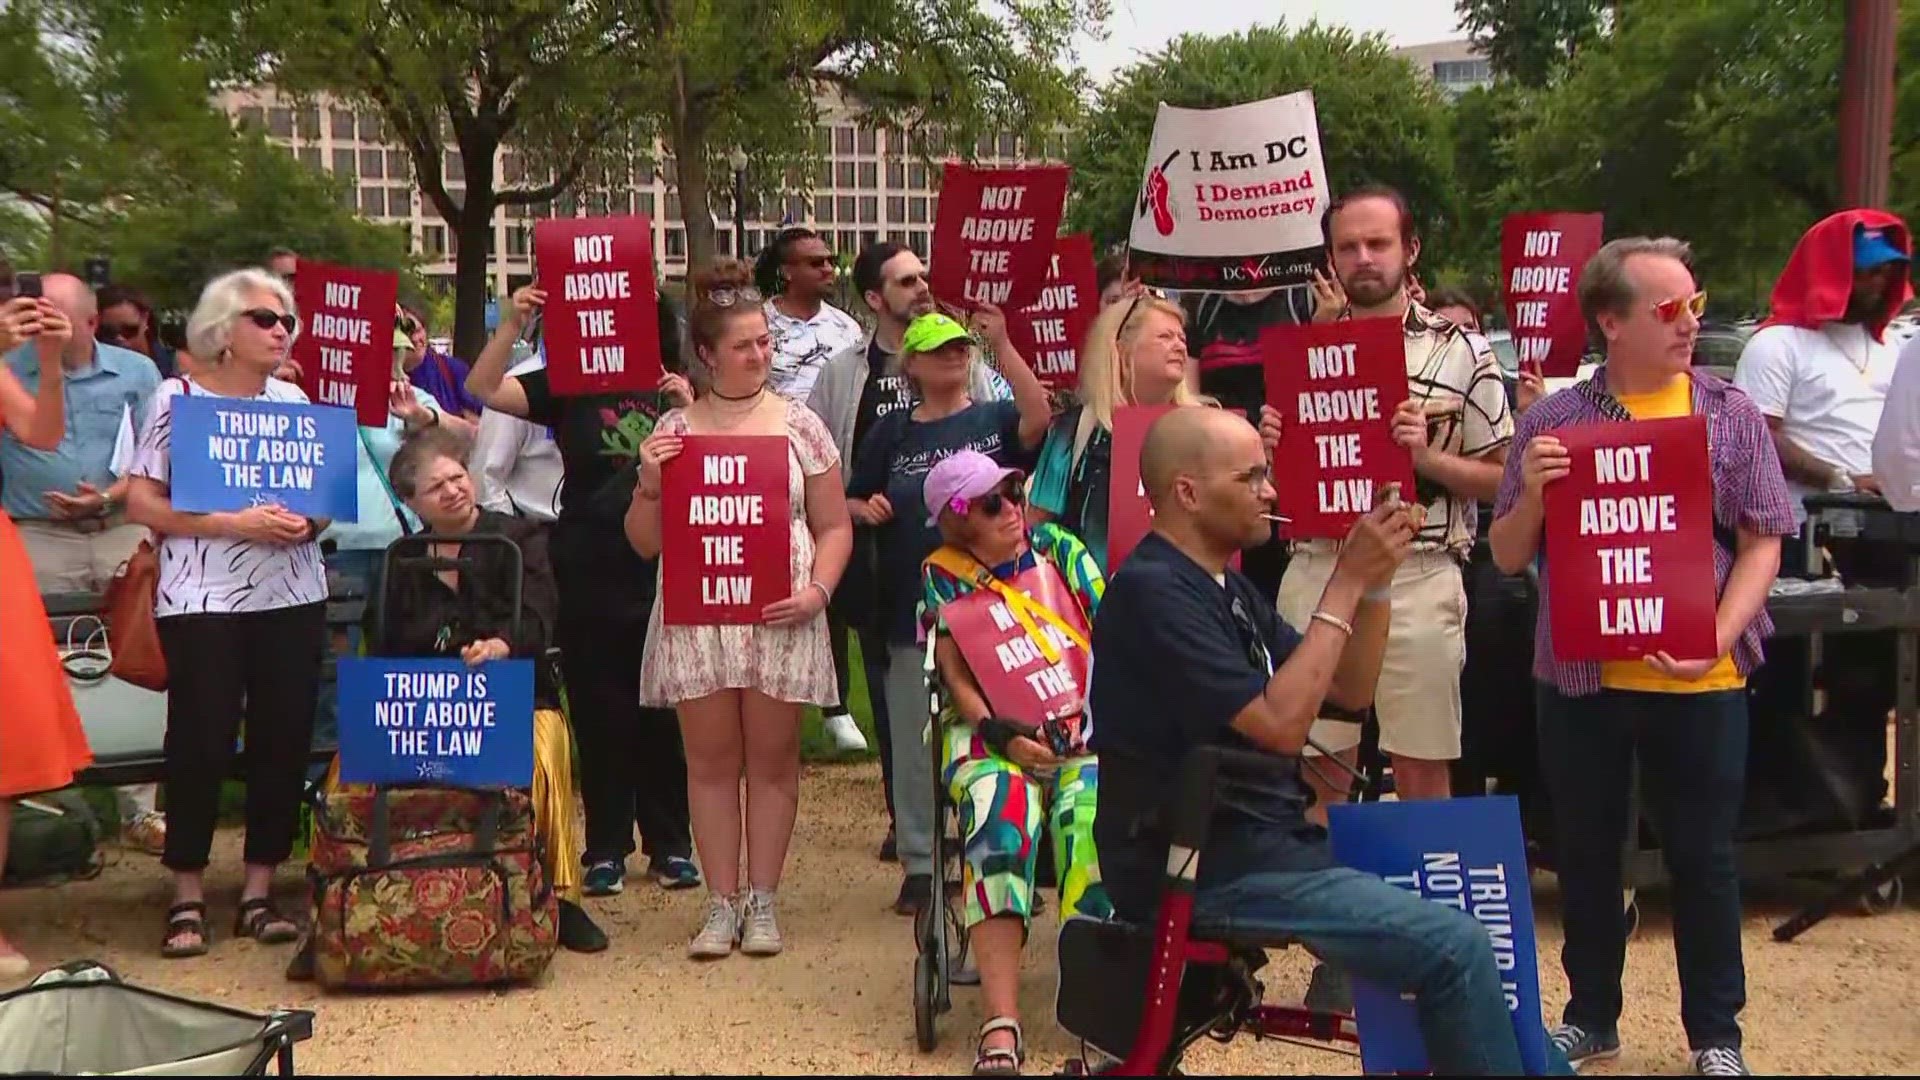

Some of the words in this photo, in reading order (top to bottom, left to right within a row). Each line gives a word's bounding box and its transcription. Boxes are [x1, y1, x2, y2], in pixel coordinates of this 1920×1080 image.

[1190, 151, 1202, 171] I
[1210, 151, 1257, 171] Am
[1264, 136, 1308, 164] DC
[980, 186, 1027, 211] NOT
[1194, 183, 1206, 203] I
[1211, 169, 1314, 202] Demand
[1199, 196, 1316, 222] Democracy
[960, 217, 1035, 242] ABOVE
[1524, 230, 1562, 258] NOT
[574, 235, 614, 264] NOT
[970, 249, 1010, 274] THE
[564, 271, 631, 301] ABOVE
[963, 278, 1013, 305] LAW
[1511, 267, 1571, 294] ABOVE
[325, 281, 361, 311] NOT
[312, 312, 372, 345] ABOVE
[576, 309, 616, 338] THE
[1516, 301, 1548, 328] THE
[1031, 319, 1067, 344] THE
[320, 346, 353, 375] THE
[580, 346, 625, 375] LAW
[1036, 349, 1076, 375] LAW
[1307, 343, 1357, 380] NOT
[318, 378, 358, 407] LAW
[1298, 387, 1381, 424] ABOVE
[216, 410, 290, 438] TRUMP
[296, 415, 317, 440] IS
[208, 435, 250, 463] NOT
[256, 439, 325, 467] ABOVE
[1314, 433, 1363, 469] THE
[1594, 445, 1652, 484] NOT
[221, 463, 262, 489] THE
[269, 466, 314, 490] LAW
[703, 455, 748, 486] NOT
[689, 495, 764, 526] ABOVE
[1317, 478, 1373, 513] LAW
[1580, 495, 1677, 535] ABOVE
[701, 536, 745, 566] THE
[1597, 546, 1652, 585] THE
[702, 576, 753, 606] LAW
[1599, 597, 1664, 636] LAW
[383, 672, 460, 699] TRUMP
[466, 672, 487, 699] IS
[1025, 661, 1078, 702] THE
[375, 701, 417, 727] NOT
[424, 701, 496, 727] ABOVE
[387, 730, 429, 756] THE
[436, 730, 483, 756] LAW
